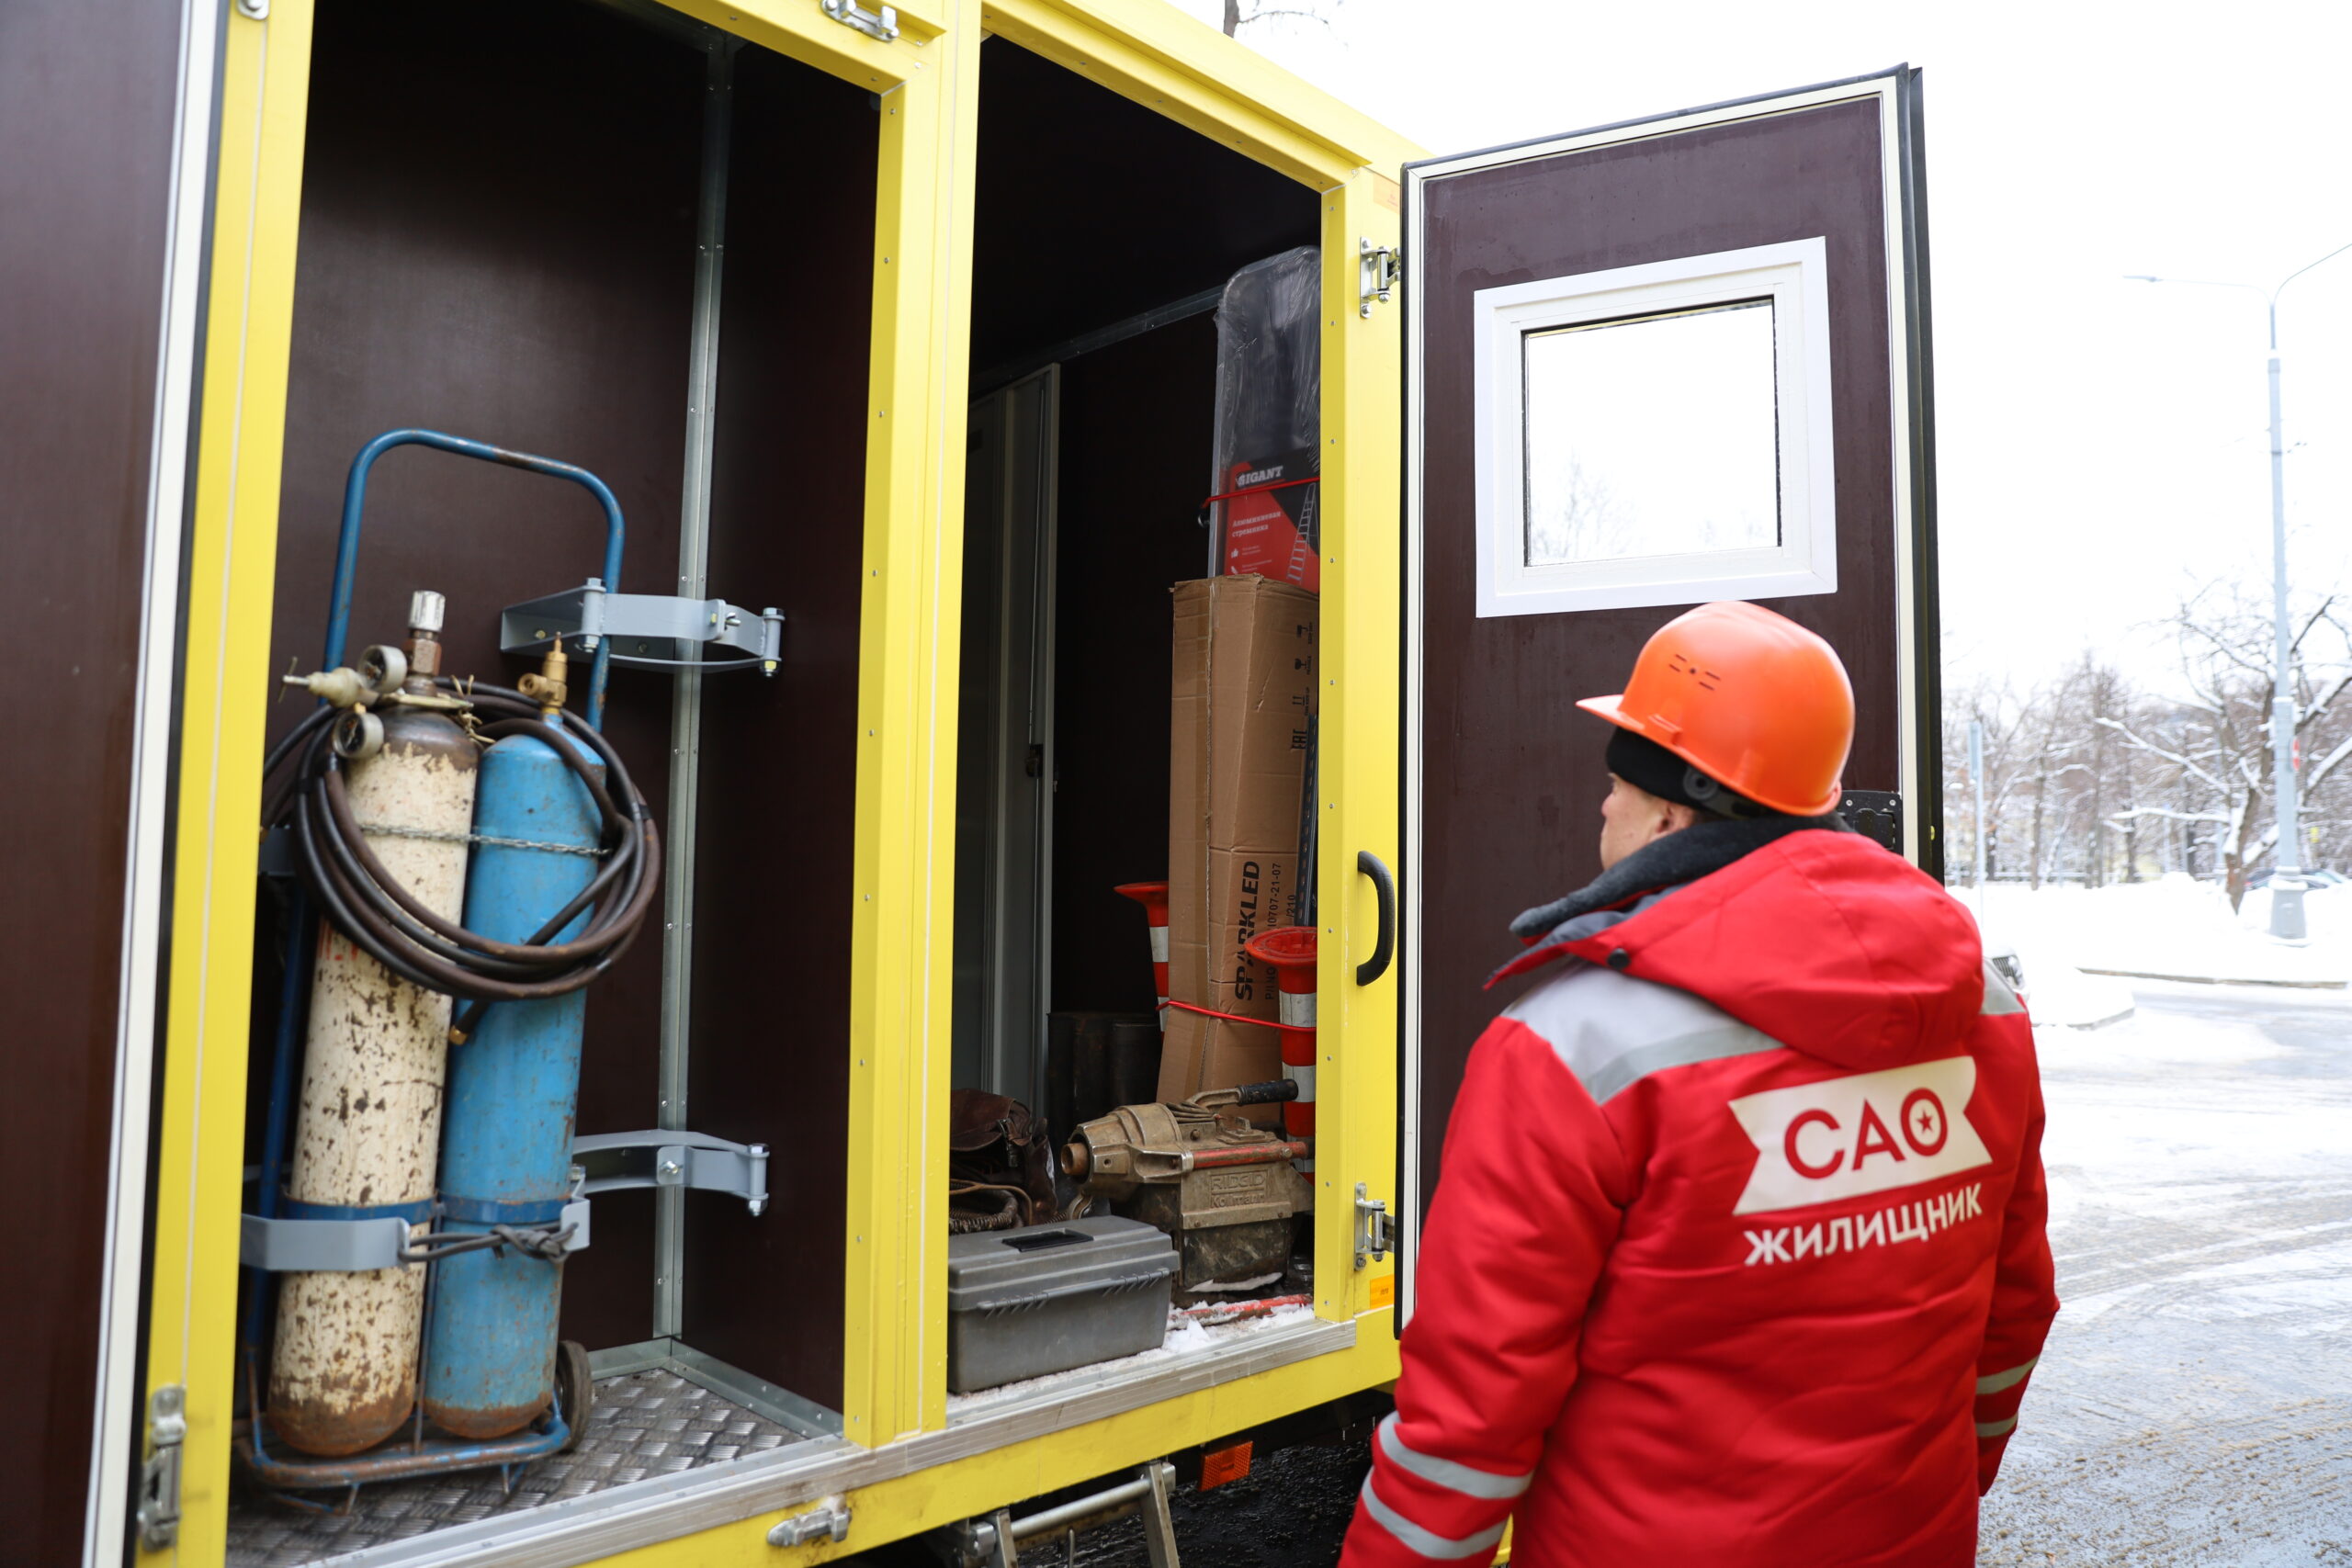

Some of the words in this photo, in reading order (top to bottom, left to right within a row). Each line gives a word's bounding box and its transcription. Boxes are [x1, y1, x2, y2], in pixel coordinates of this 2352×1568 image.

[1236, 466, 1283, 488] GIGANT
[1234, 861, 1260, 1001] SPARKLED
[1784, 1087, 1948, 1179] САО
[1211, 1173, 1265, 1190] RIDGID
[1743, 1182, 1983, 1266] ЖИЛИЩНИК
